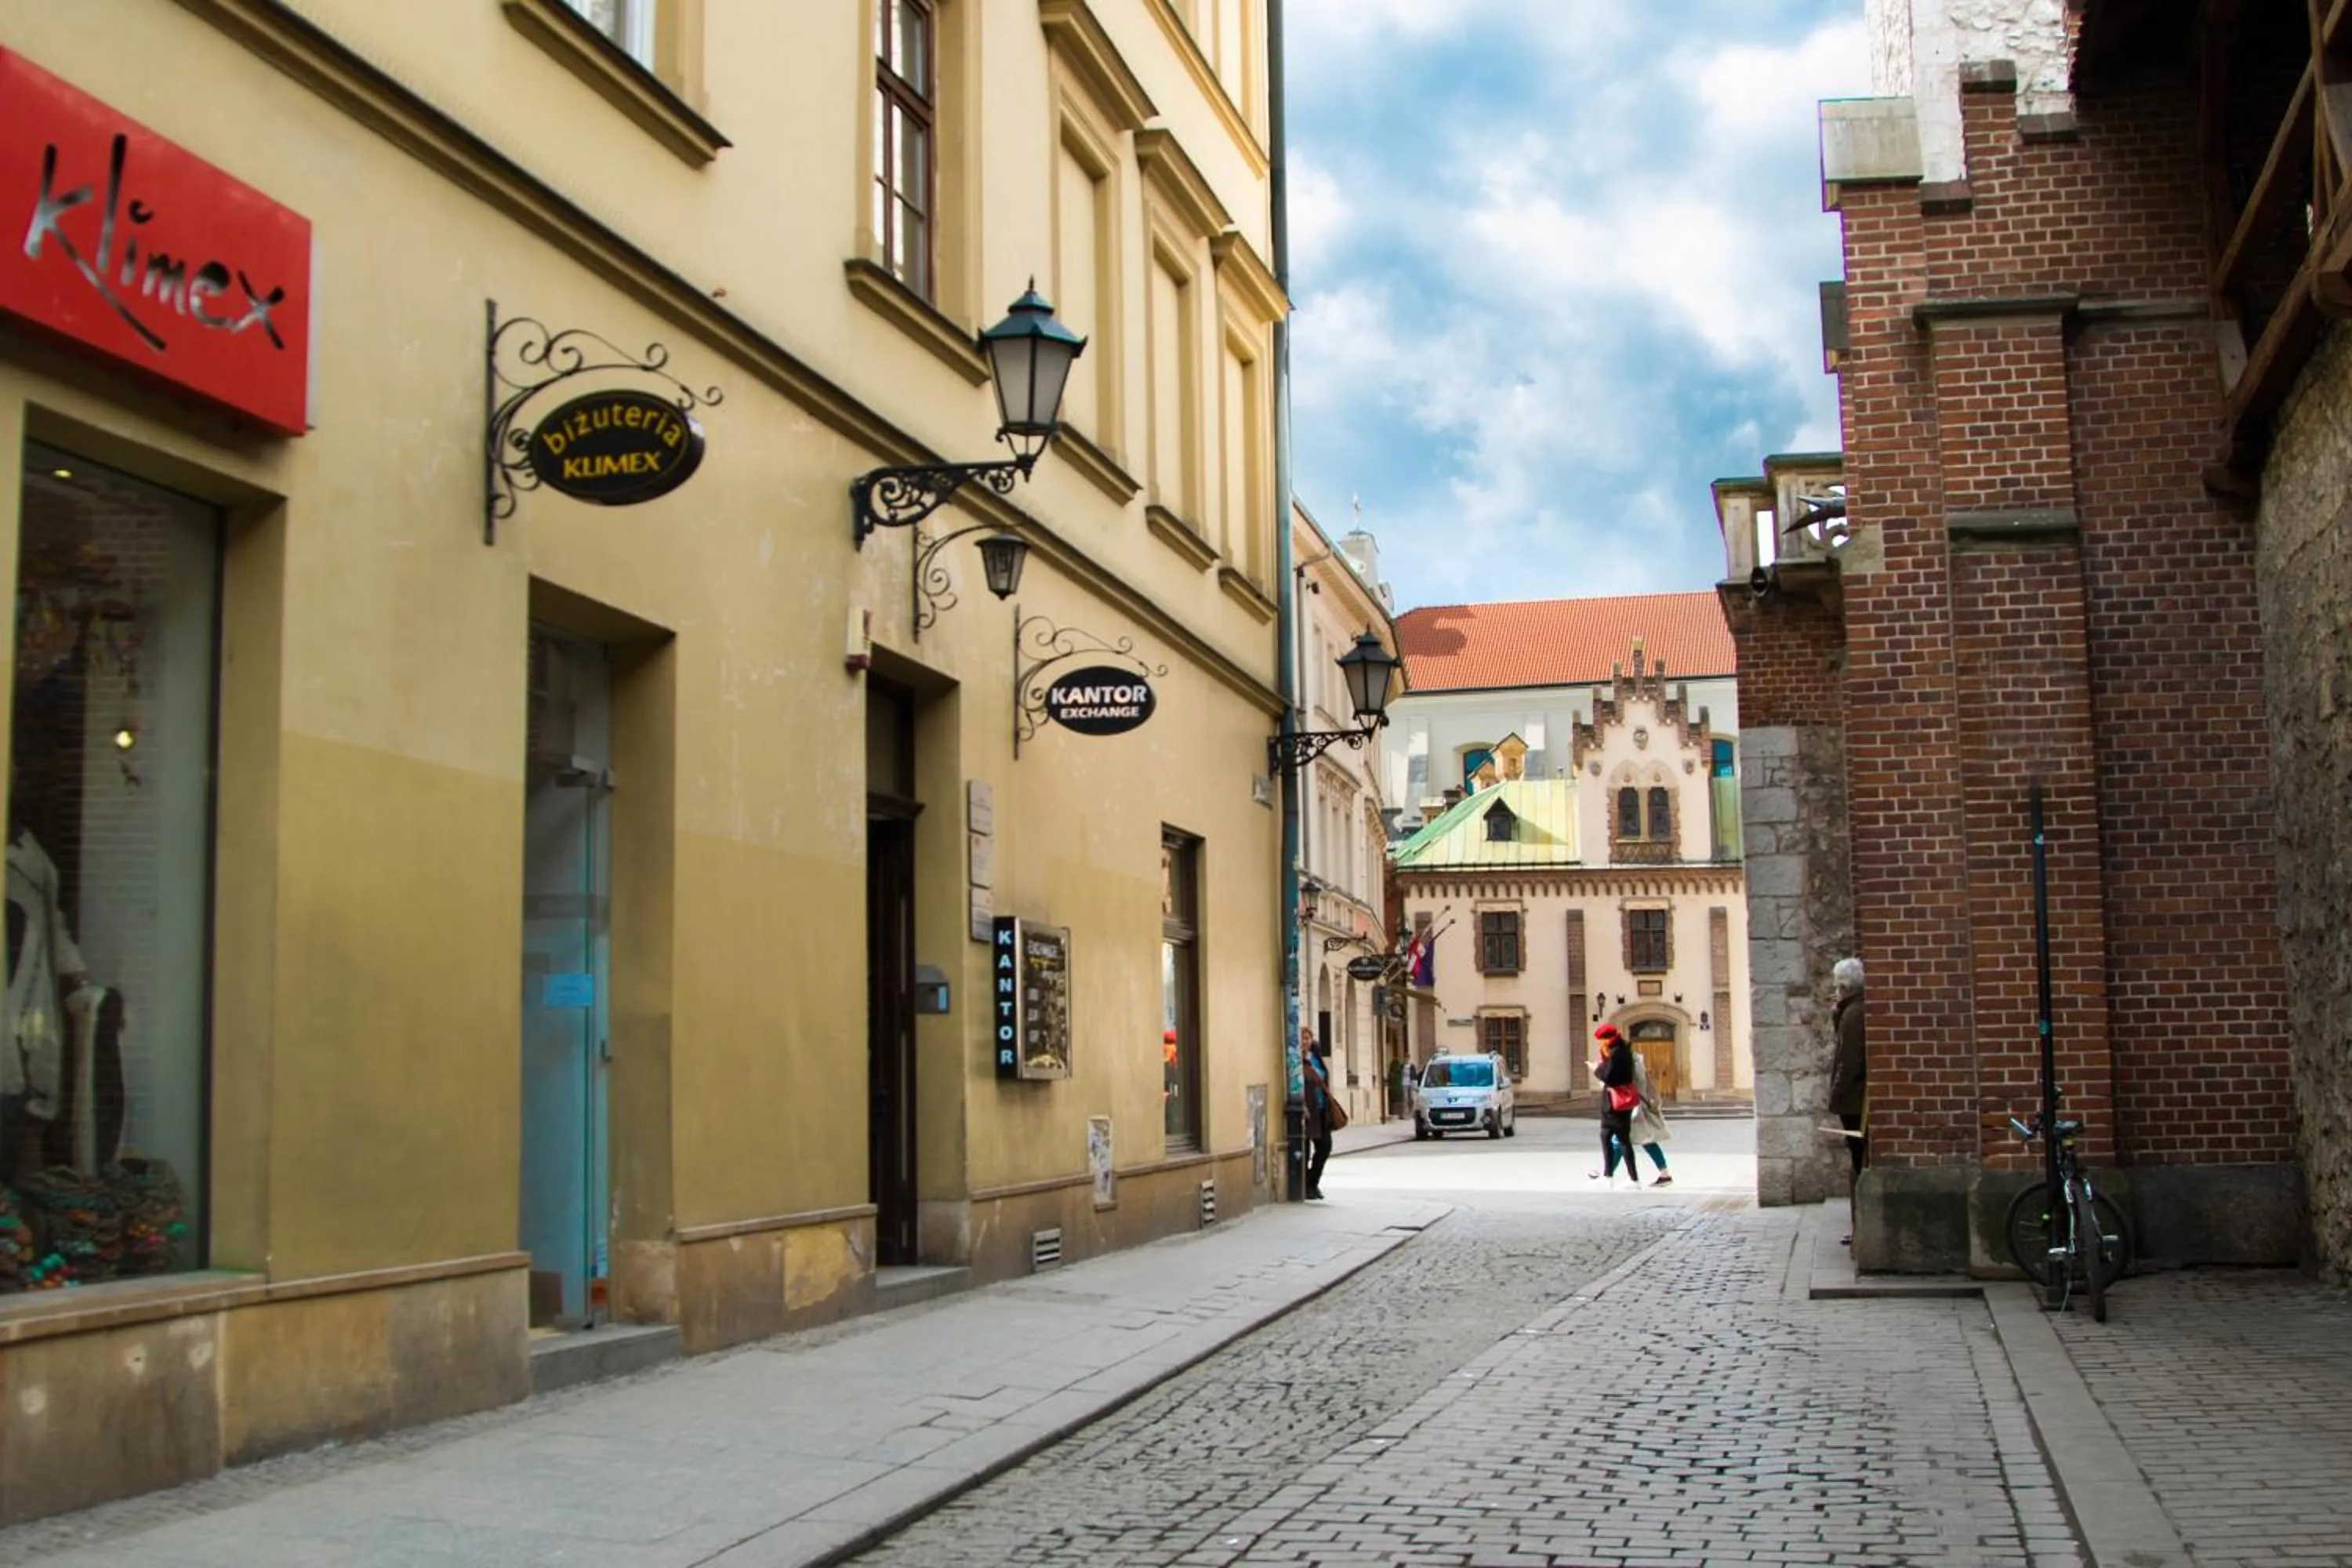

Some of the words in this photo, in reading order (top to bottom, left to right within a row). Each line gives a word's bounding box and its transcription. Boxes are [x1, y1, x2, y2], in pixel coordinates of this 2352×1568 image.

[564, 452, 661, 479] KLIMEX
[1051, 685, 1148, 705] KANTOR
[1060, 706, 1139, 719] EXCHANGE
[998, 930, 1014, 1065] KANTOR
